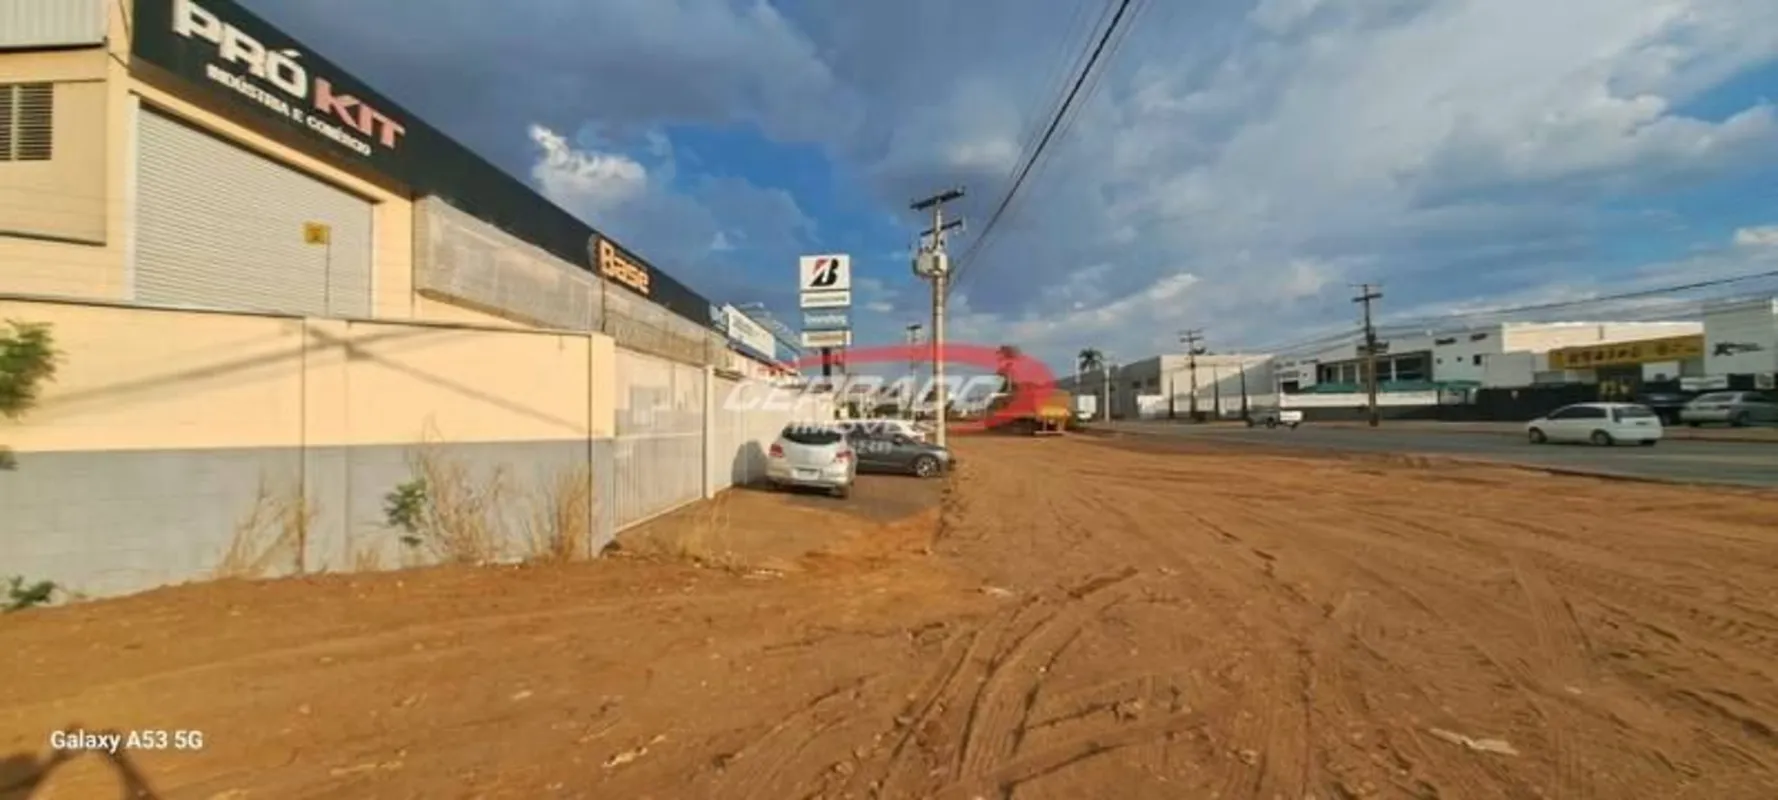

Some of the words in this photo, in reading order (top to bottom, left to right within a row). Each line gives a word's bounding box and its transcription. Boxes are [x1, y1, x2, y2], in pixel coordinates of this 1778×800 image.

[172, 0, 308, 99] PRÓ
[314, 77, 406, 149] KIT
[206, 63, 290, 117] INDÚSTRIA
[292, 108, 304, 124] E
[306, 115, 372, 157] COMÉRCIO
[599, 238, 650, 295] Base
